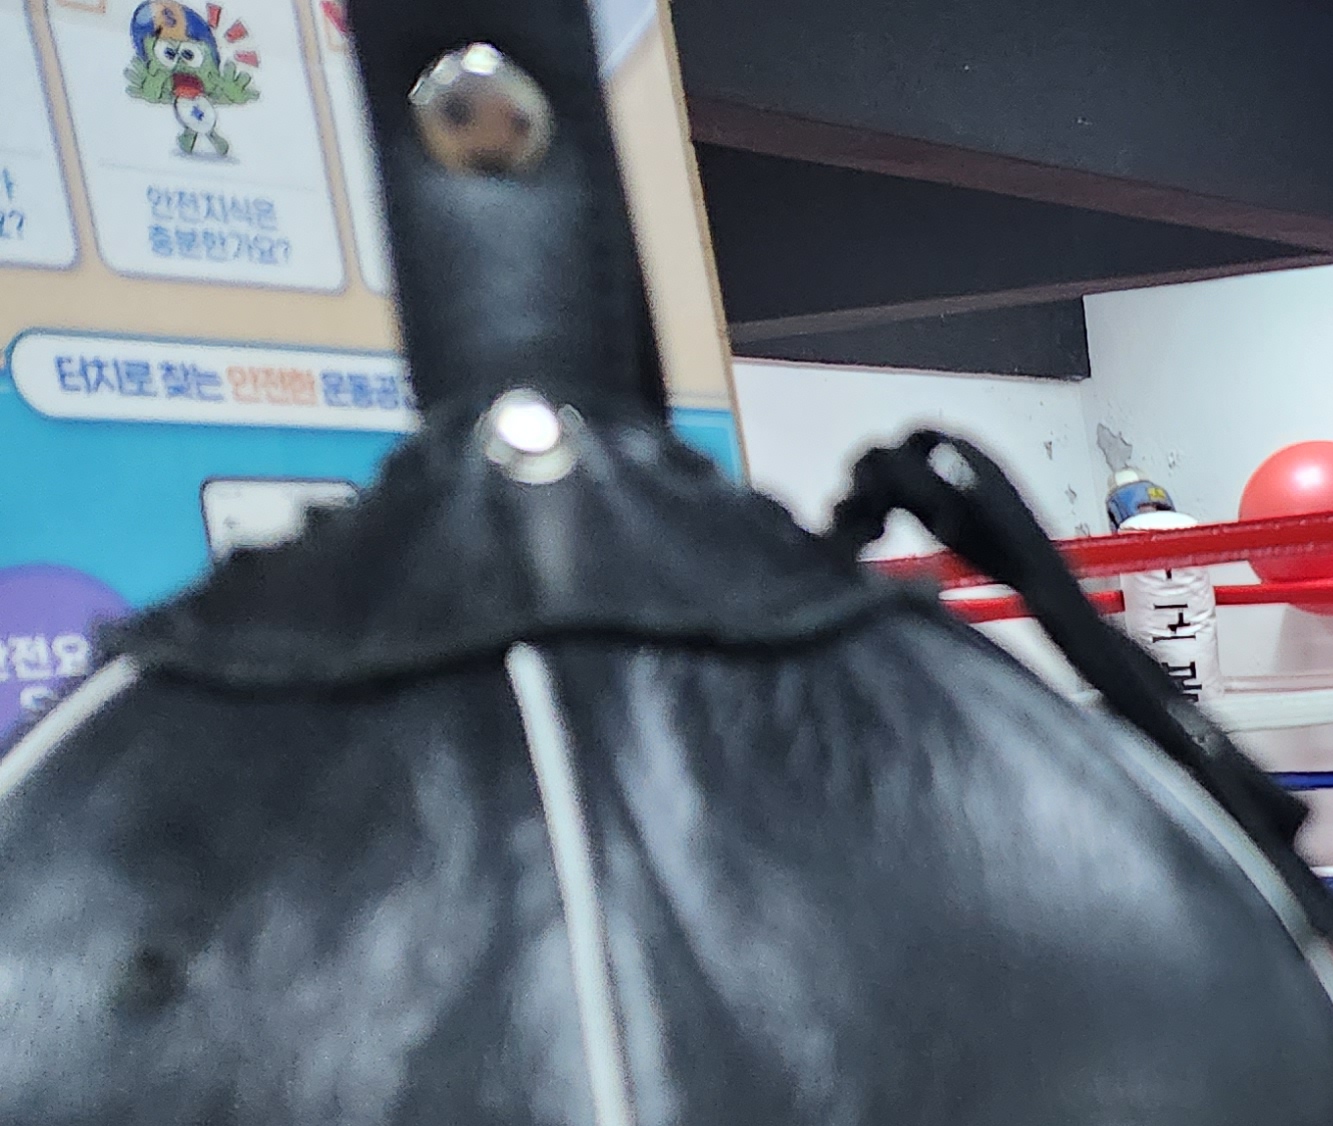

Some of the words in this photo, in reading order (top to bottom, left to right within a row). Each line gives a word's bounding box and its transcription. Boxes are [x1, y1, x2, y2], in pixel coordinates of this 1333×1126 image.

[146, 185, 278, 231] 안전지식은
[149, 225, 291, 264] 충분한가요?
[55, 355, 157, 397] 터치로
[158, 360, 225, 401] 찾는
[226, 365, 318, 406] 안전한
[320, 371, 412, 410] 운동공
